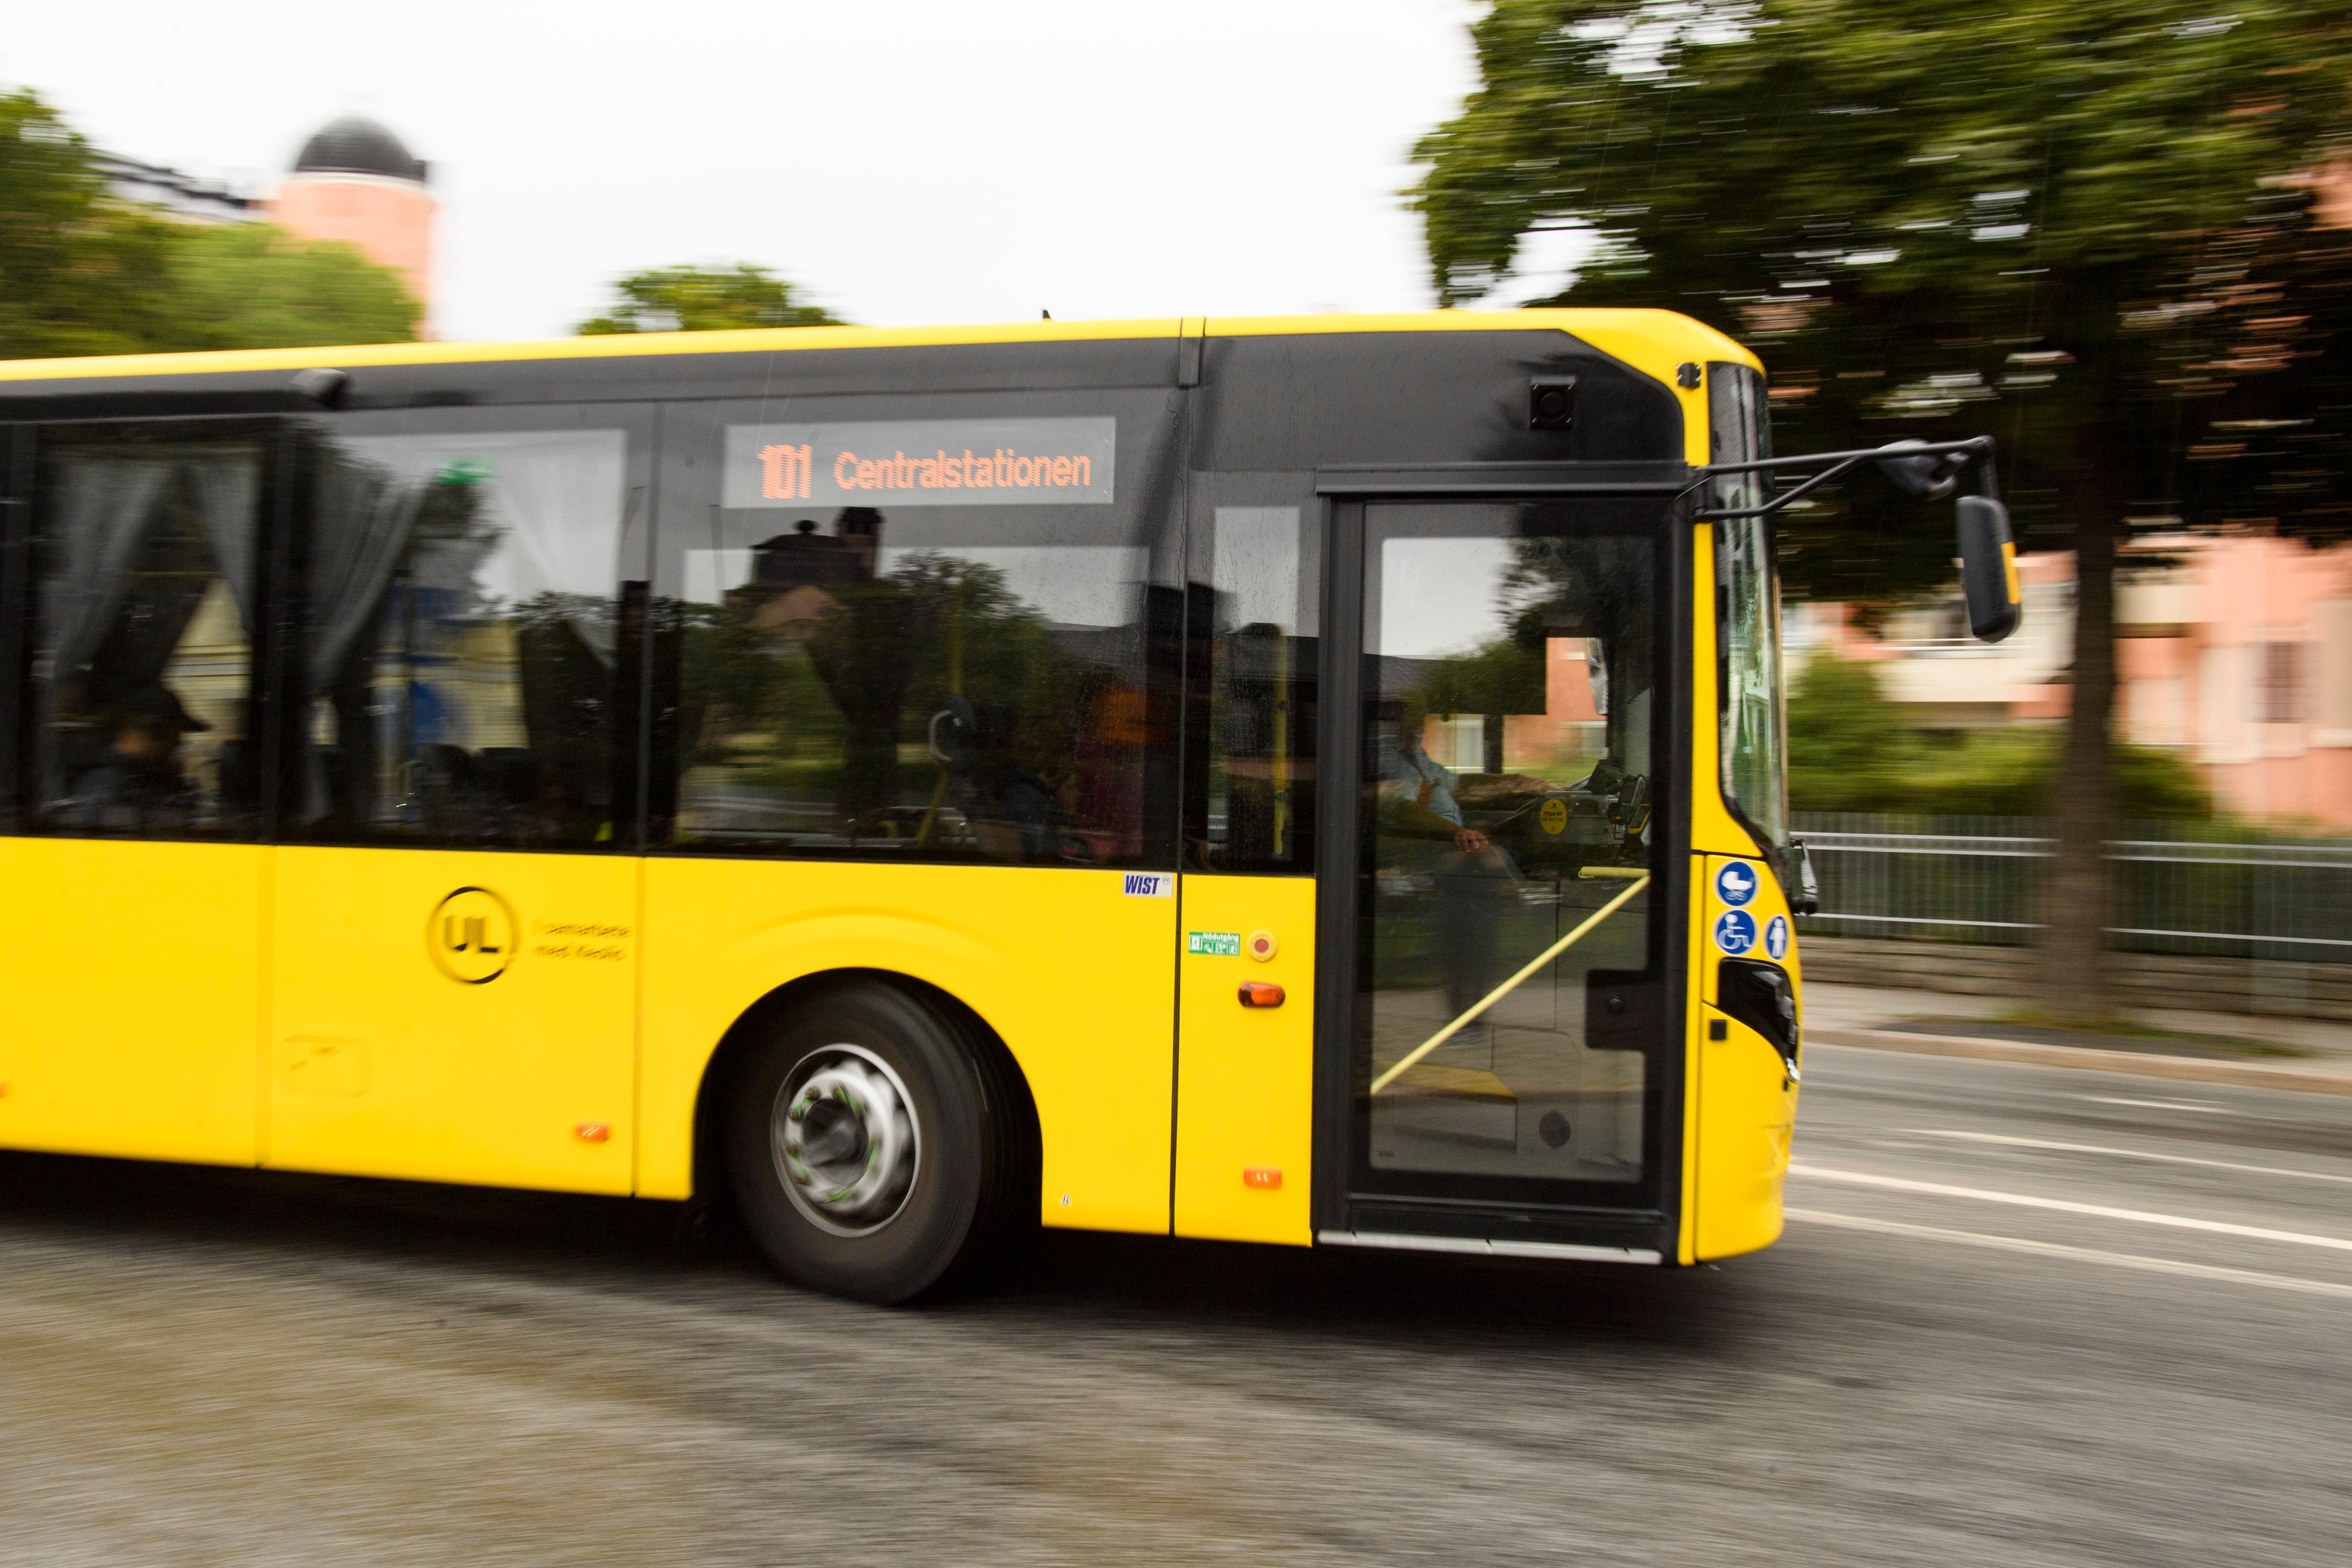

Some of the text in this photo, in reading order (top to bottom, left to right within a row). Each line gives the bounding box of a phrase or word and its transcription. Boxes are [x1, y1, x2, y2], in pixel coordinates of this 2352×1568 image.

[757, 444, 1091, 499] 101 Centralstationen
[1125, 875, 1160, 894] WIST
[443, 916, 500, 953] UL
[1203, 932, 1239, 943] Nödutgång
